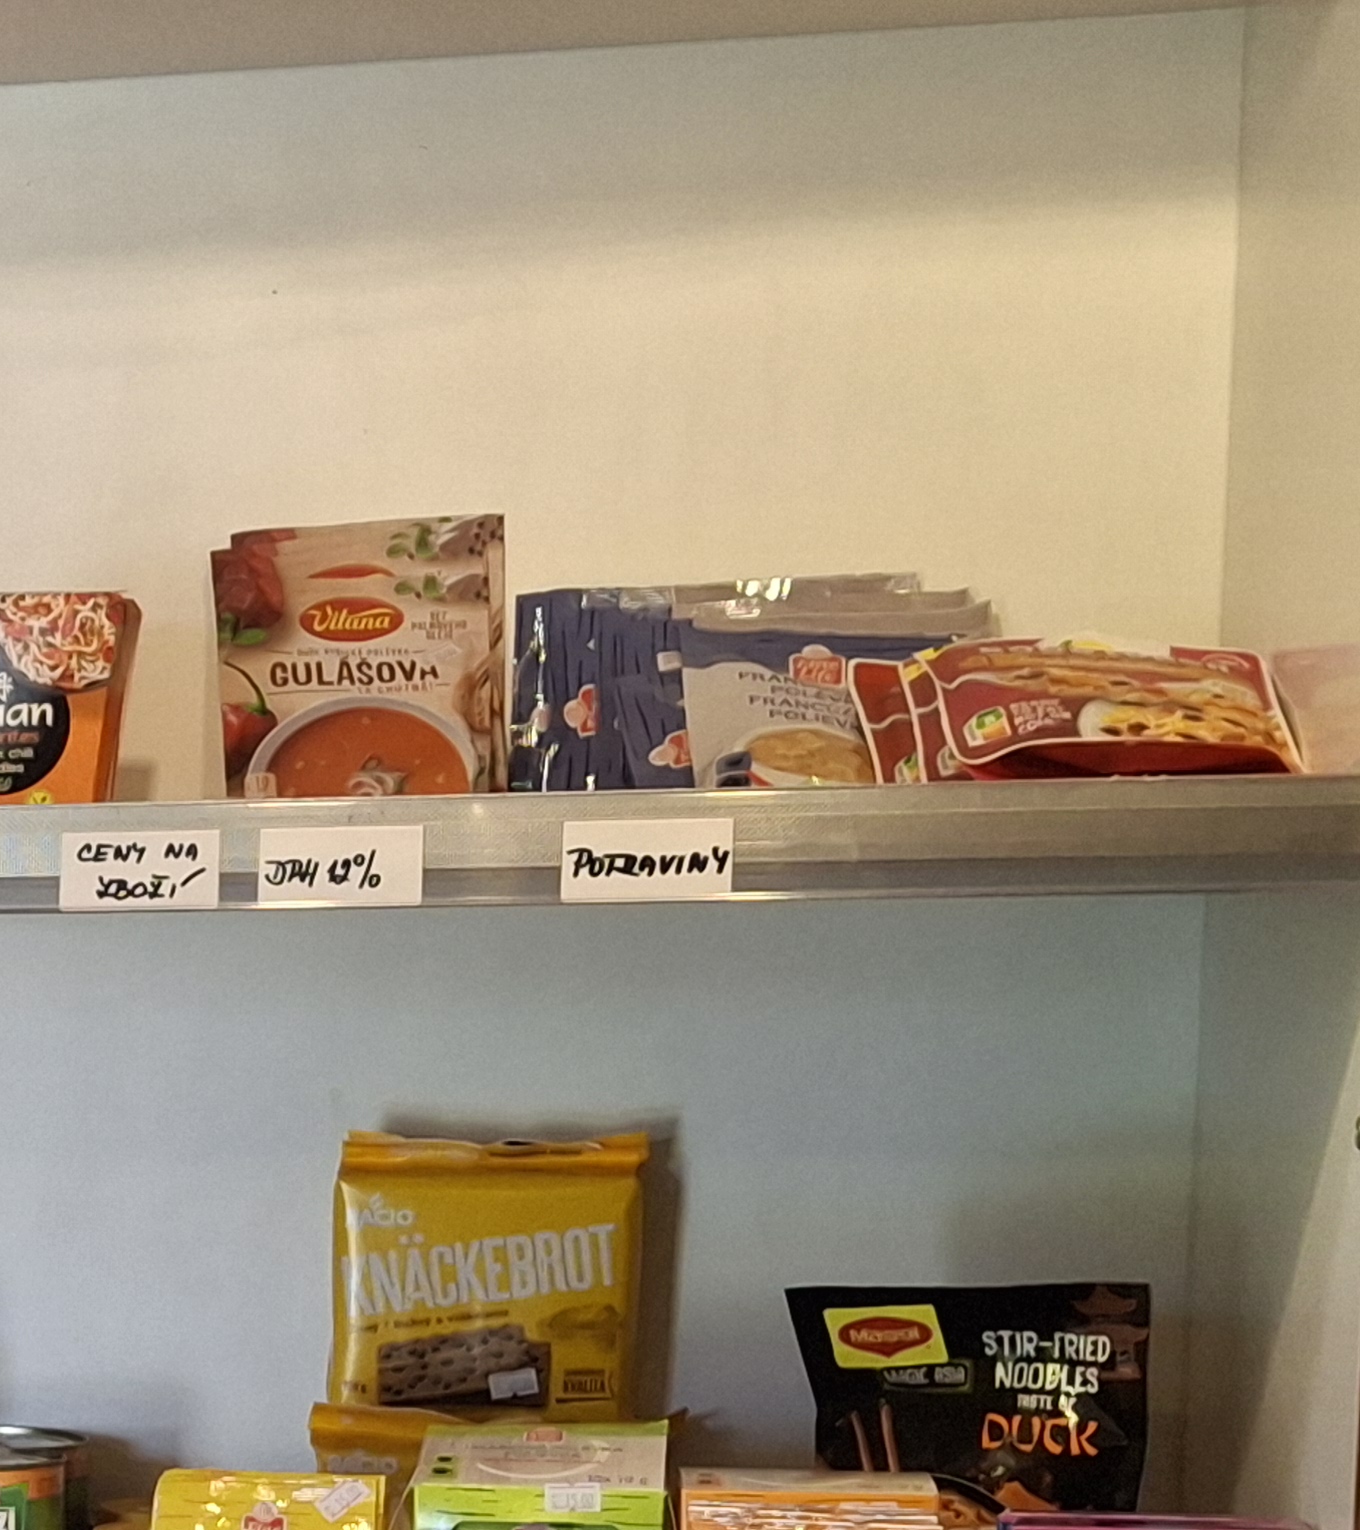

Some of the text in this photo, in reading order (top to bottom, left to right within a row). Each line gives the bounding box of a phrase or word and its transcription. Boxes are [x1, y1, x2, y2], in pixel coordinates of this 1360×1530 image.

[75, 841, 199, 864] CENY NA
[263, 848, 383, 890] DPH 12%
[566, 842, 732, 882] POTRAVINY
[340, 1222, 618, 1317] KNÄCKEBROT
[981, 1329, 1111, 1364] STIR-FRIED
[994, 1361, 1100, 1394] NOODLES
[981, 1411, 1100, 1458] DUCK
